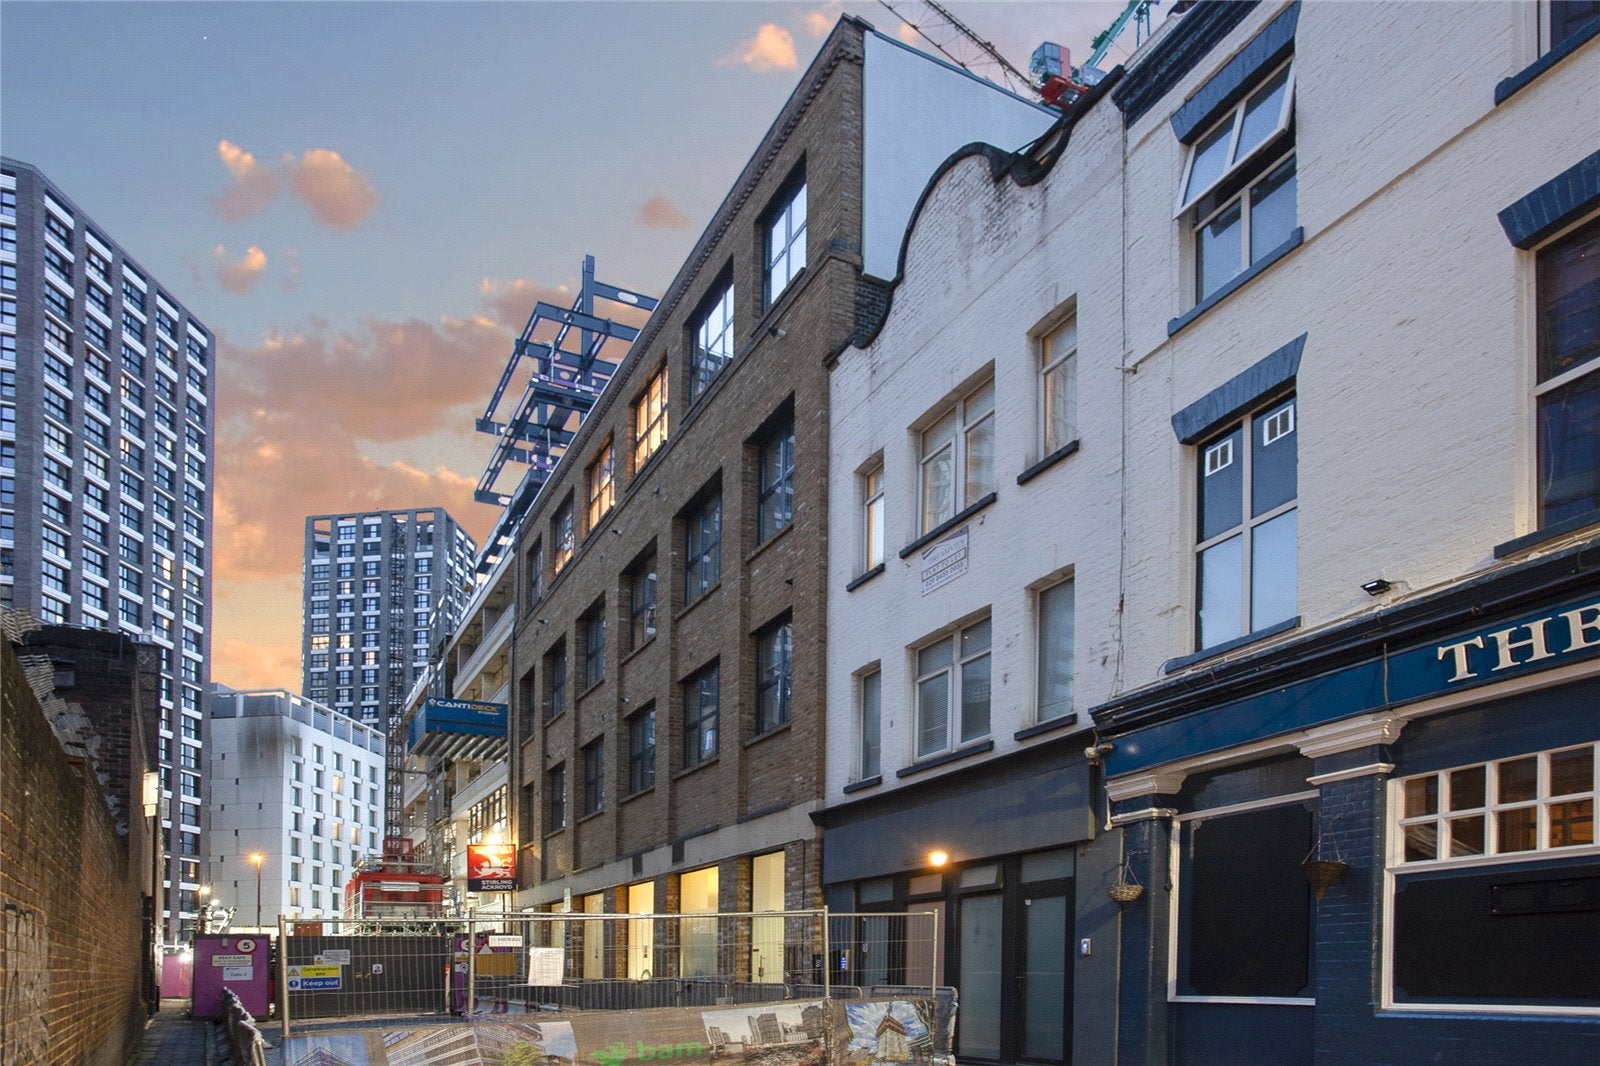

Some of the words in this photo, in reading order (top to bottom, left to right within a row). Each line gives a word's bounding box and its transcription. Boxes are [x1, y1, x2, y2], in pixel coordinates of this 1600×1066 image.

[1438, 603, 1600, 682] THE
[437, 701, 498, 711] CANTIDECK
[243, 942, 251, 950] 5
[636, 1040, 704, 1061] bam
